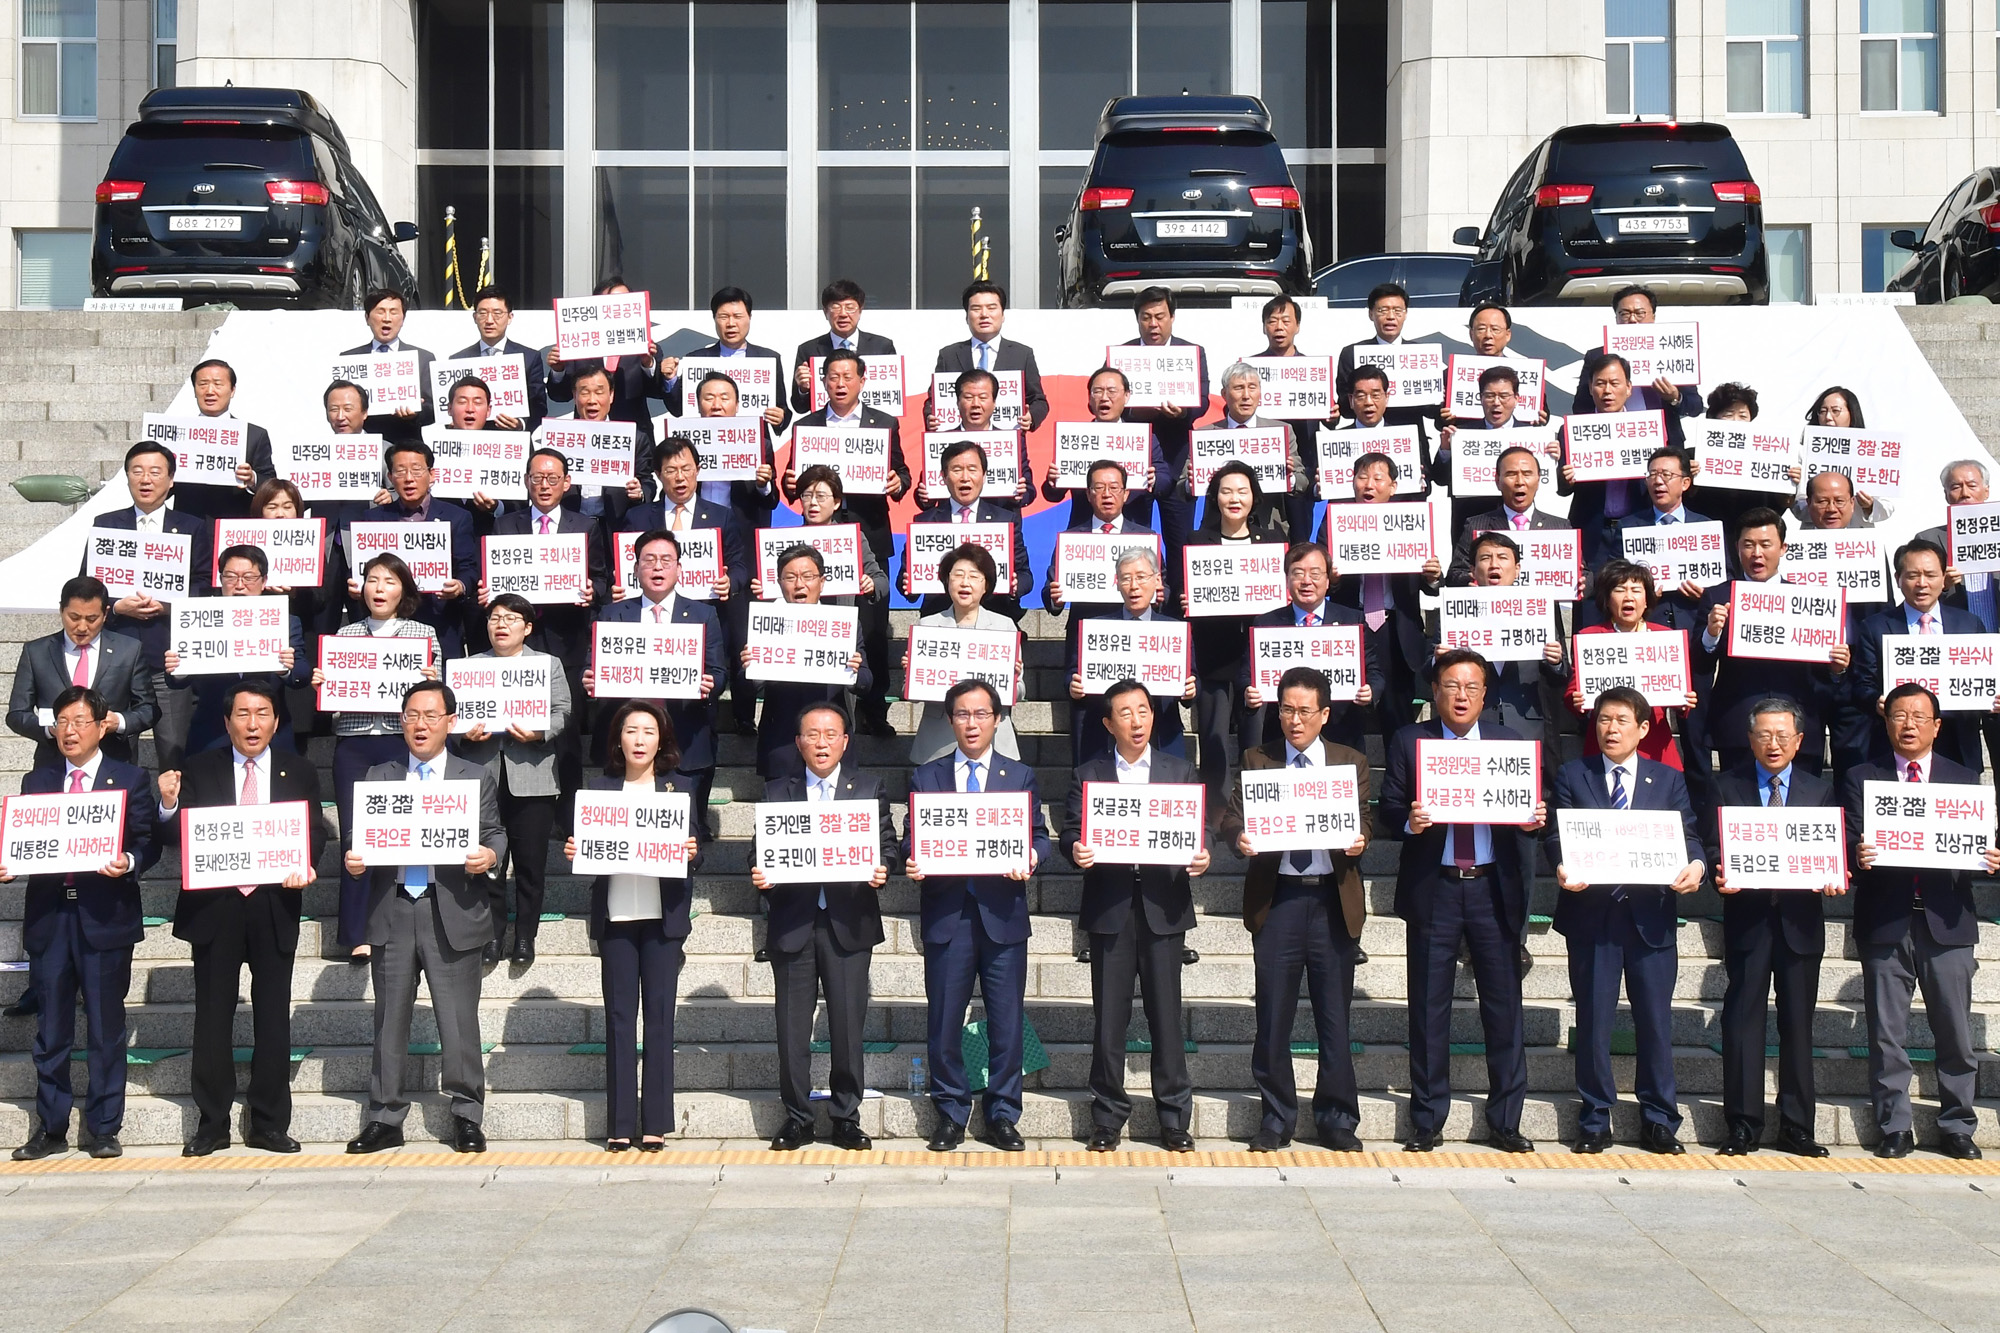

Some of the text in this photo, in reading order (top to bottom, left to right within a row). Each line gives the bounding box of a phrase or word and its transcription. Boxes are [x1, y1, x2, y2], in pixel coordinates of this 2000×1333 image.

[176, 218, 234, 228] 68호 2129
[1164, 223, 1220, 234] 39호 4142
[1625, 219, 1682, 229] 43호 9753
[562, 303, 641, 322] 민주당의 댓글공작
[561, 328, 646, 348] 진상규명 일벌백계
[1612, 335, 1693, 351] 국정원댓글 수사하듯
[1157, 358, 1193, 372] 여론조작
[1399, 354, 1438, 369] 댓글공작
[1657, 359, 1694, 374] 수사하라
[1281, 368, 1327, 381] 18억원 증발
[1403, 378, 1442, 395] 일벌백계
[1289, 392, 1326, 406] 규명하라
[189, 428, 239, 445] 18억원 증발
[718, 429, 756, 444] 국회사찰
[1573, 420, 1658, 441] 민주당의 댓글공작
[546, 432, 631, 451] 댓글공작 여론조작
[801, 436, 884, 455] 청와대의 인사참사
[1061, 435, 1144, 451] 헌정유린 국회사찰
[1197, 437, 1281, 456] 민주당의 댓글공작
[1752, 435, 1790, 453] 부실수사
[1812, 437, 1850, 454] 증거인멸
[293, 445, 378, 461] 민주당의 댓글공작
[722, 454, 757, 469] 규탄한다
[591, 459, 630, 475] 일벌백계
[846, 465, 884, 482] 사과하라
[1705, 458, 1742, 475] 특검으로
[338, 470, 382, 489] 일벌백계
[1857, 467, 1900, 486] 분노한다
[1337, 514, 1425, 532] 청와대의 인사참사
[273, 530, 315, 546] 인사참사
[357, 533, 446, 550] 청와대의 인사참사
[144, 543, 183, 563] 부실수사
[491, 547, 581, 565] 헌정유린 국회사찰
[1340, 543, 1428, 561] 대통령은 사과하라
[1835, 541, 1875, 559] 부실수사
[273, 558, 315, 574] 사과하라
[1192, 557, 1280, 576] 헌정유린 국회사찰
[143, 571, 184, 591] 진상규명
[492, 574, 583, 593] 문재인정권 규탄한다
[1837, 570, 1880, 590] 진상규명
[1193, 585, 1282, 603] 문재인정권 규탄한다
[1491, 598, 1547, 616] 18억원 증발
[1741, 593, 1836, 617] 청와대의 인사참사
[180, 610, 223, 628] 증거인멸
[797, 620, 851, 638] 18억원 증발
[1501, 628, 1548, 647] 규명하라
[1741, 624, 1839, 649] 대통령은 사과하라
[234, 639, 283, 659] 분노한다
[602, 637, 698, 655] 헌정유린 국회사찰
[917, 640, 1011, 662] 댓글공작 은폐조작
[1088, 634, 1182, 653] 헌정유린 국회사찰
[1260, 640, 1355, 658] 댓글공작 은폐조작
[327, 652, 377, 669] 국정원댓글
[1583, 645, 1679, 665] 헌정유린 국회사찰
[1949, 647, 1993, 665] 부실수사
[452, 669, 546, 689] 청와대의 인사참사
[600, 666, 698, 685] 독재정치 부활인가?
[1142, 665, 1181, 682] 규탄한다
[1641, 674, 1681, 692] 규탄한다
[327, 680, 371, 698] 댓글공작
[1949, 678, 1996, 696] 진상규명
[1427, 757, 1530, 776] 국정원댓글 수사하듯
[1294, 780, 1353, 800] 18억원 증발
[1427, 788, 1531, 808] 댓글공작 수사하라
[422, 795, 467, 814] 부실수사
[1093, 798, 1197, 819] 댓글공작 은폐조작
[1935, 799, 1984, 820] 부실수사
[12, 804, 115, 827] 청와대의 인사참사
[581, 806, 684, 829] 청와대의 인사참사
[765, 815, 811, 835] 증거인멸
[920, 808, 1024, 826] 댓글공작 은폐조작
[1248, 813, 1355, 835] 특검으로 규명하라
[195, 819, 301, 841] 헌정유린 국회사찰
[365, 828, 469, 848] 특검으로 진상규명
[1092, 829, 1196, 850] 특검으로 규명하라
[1729, 823, 1836, 842] 댓글공작 여론조작
[11, 837, 114, 860] 대통령은 사과하라
[582, 840, 687, 863] 대통령은 사과하라
[921, 839, 1023, 858] 특검으로 규명하라
[1875, 830, 1989, 856] 특검으로 진상규명
[195, 849, 302, 872] 문재인정권 규탄한다
[823, 846, 874, 866] 분노한다
[1731, 855, 1838, 874] 특검으로 일벌백계
